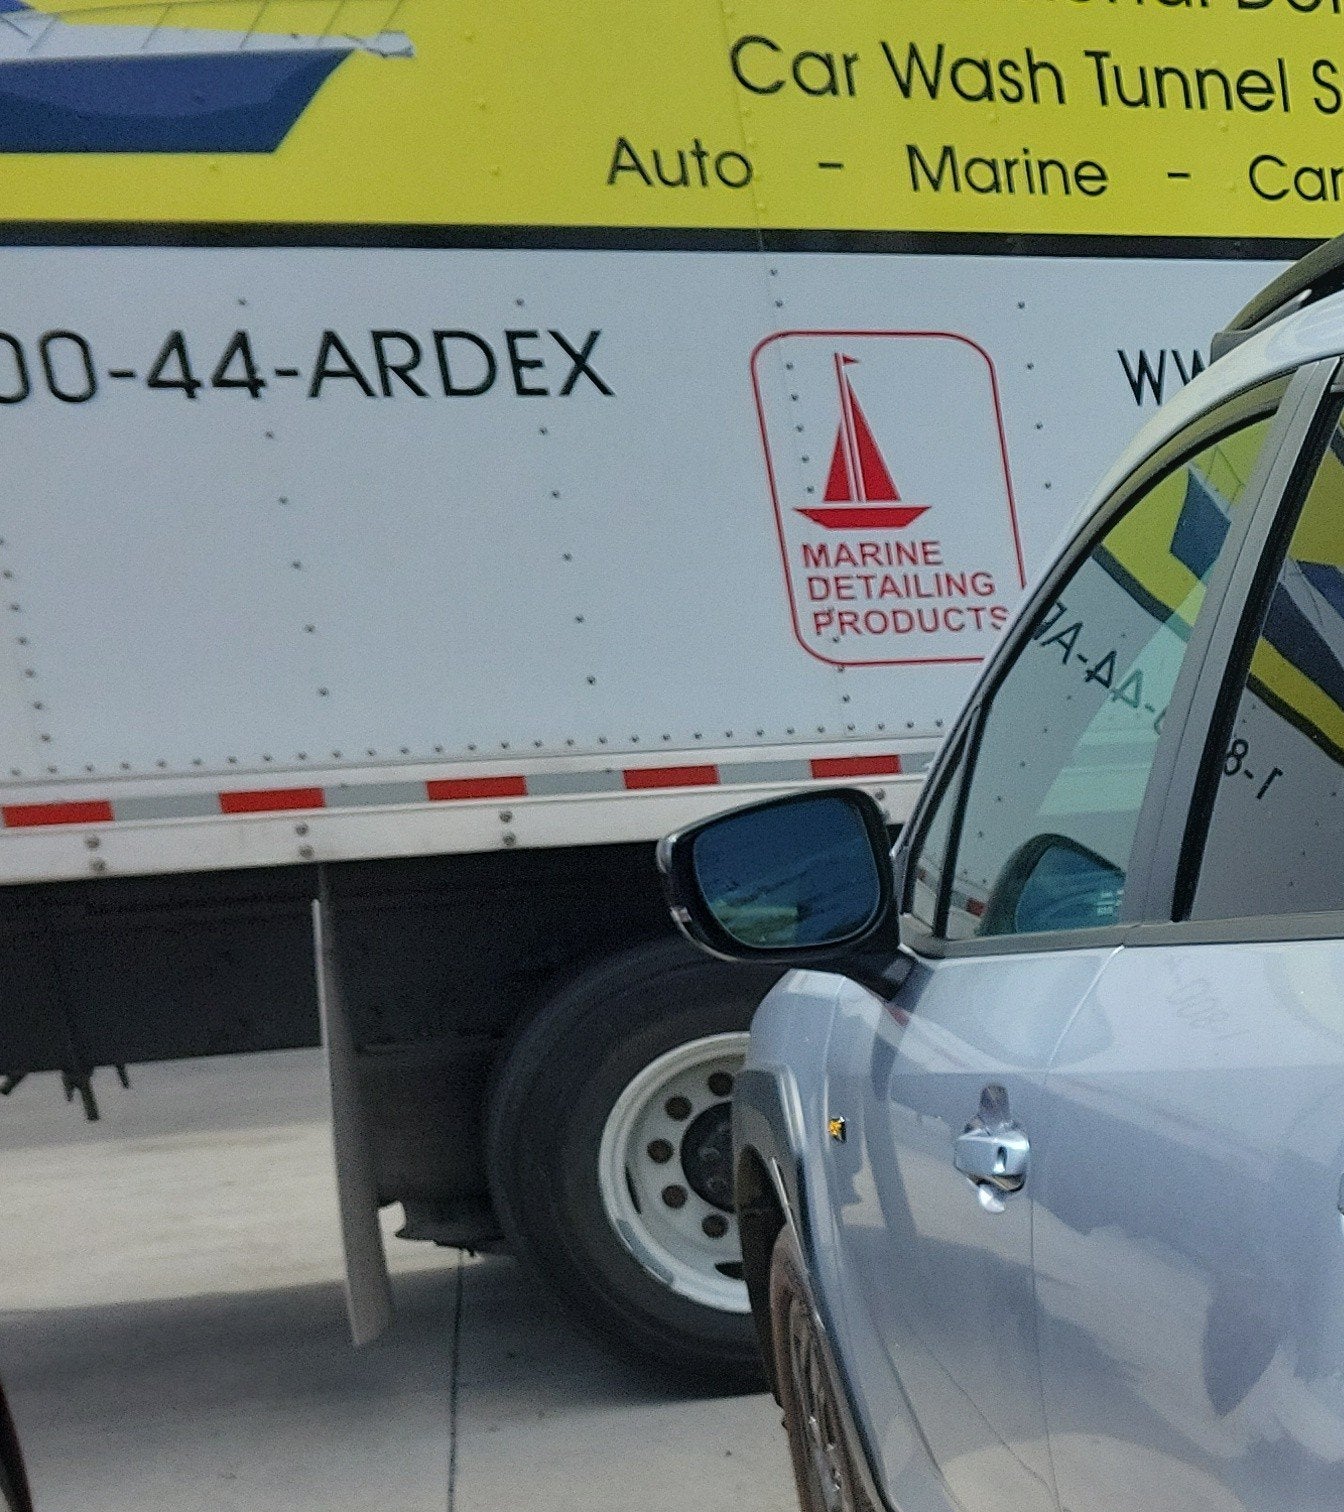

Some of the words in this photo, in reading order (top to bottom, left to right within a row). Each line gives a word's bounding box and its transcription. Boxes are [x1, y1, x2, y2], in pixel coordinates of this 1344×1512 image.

[729, 35, 859, 97] Car
[880, 41, 1066, 105] Wash
[1084, 49, 1291, 113] Tunnel
[607, 136, 753, 188] Auto
[906, 144, 1109, 197] Marine
[801, 540, 943, 568] MARINE
[807, 571, 996, 601] DETAILING
[813, 605, 1009, 636] PRODUCTS
